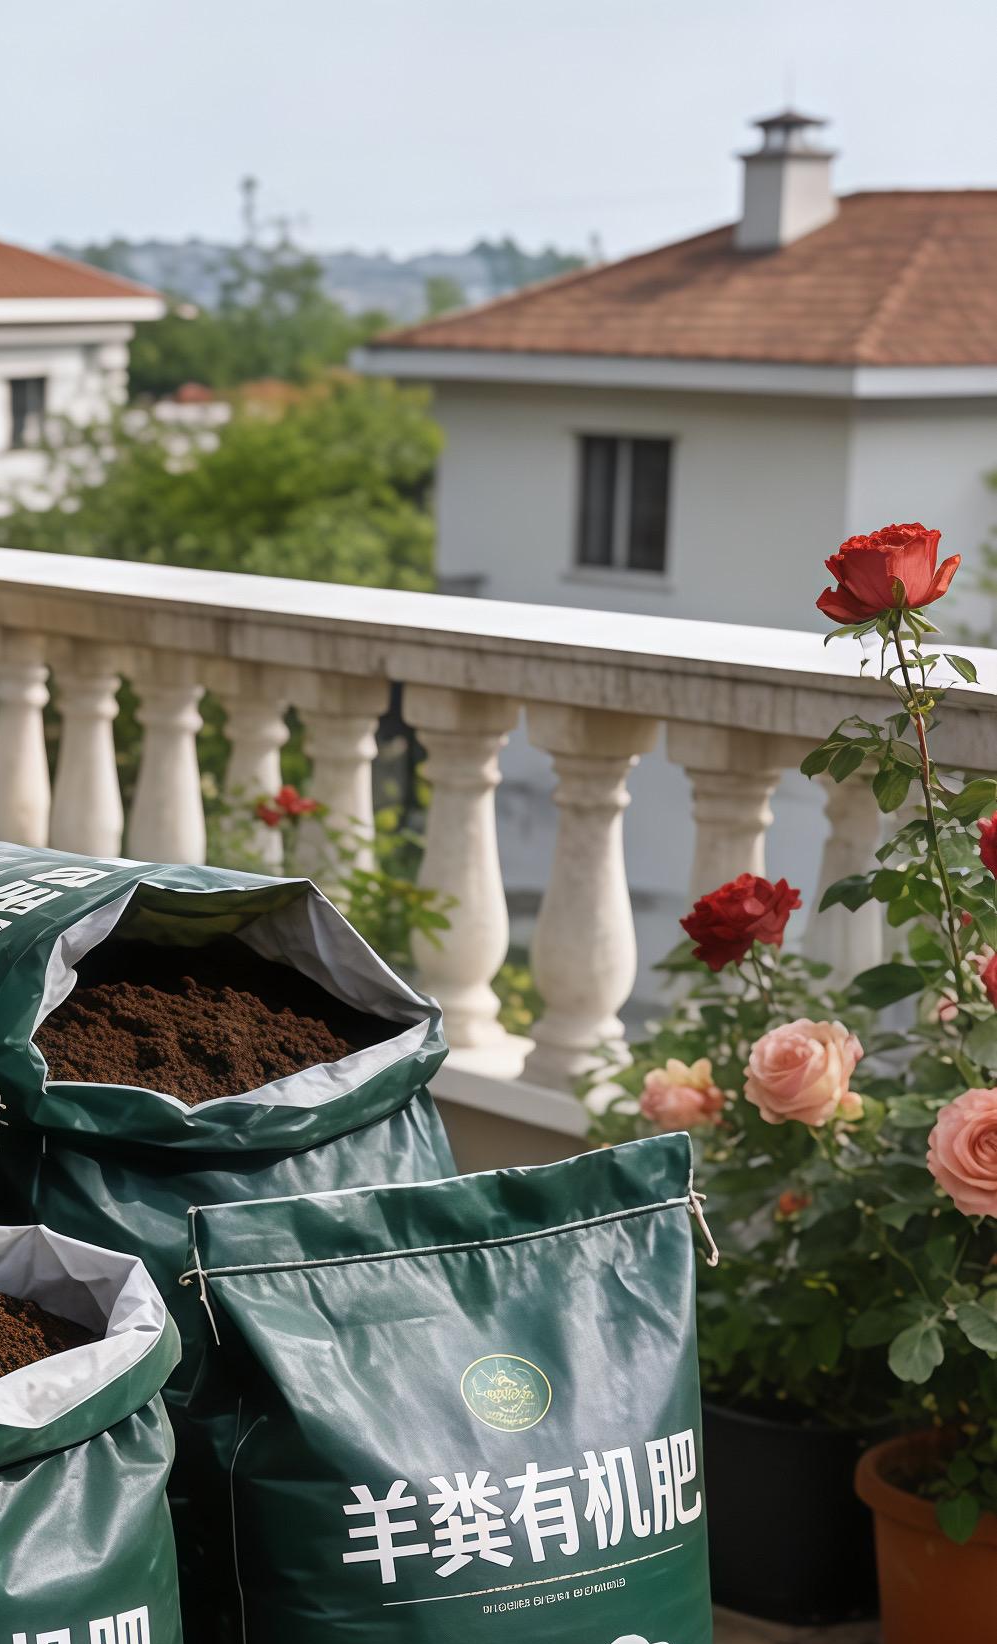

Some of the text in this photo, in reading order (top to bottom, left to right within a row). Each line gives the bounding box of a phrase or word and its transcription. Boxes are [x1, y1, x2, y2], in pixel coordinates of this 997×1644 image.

[342, 1428, 703, 1585] 羊粪有机肥
